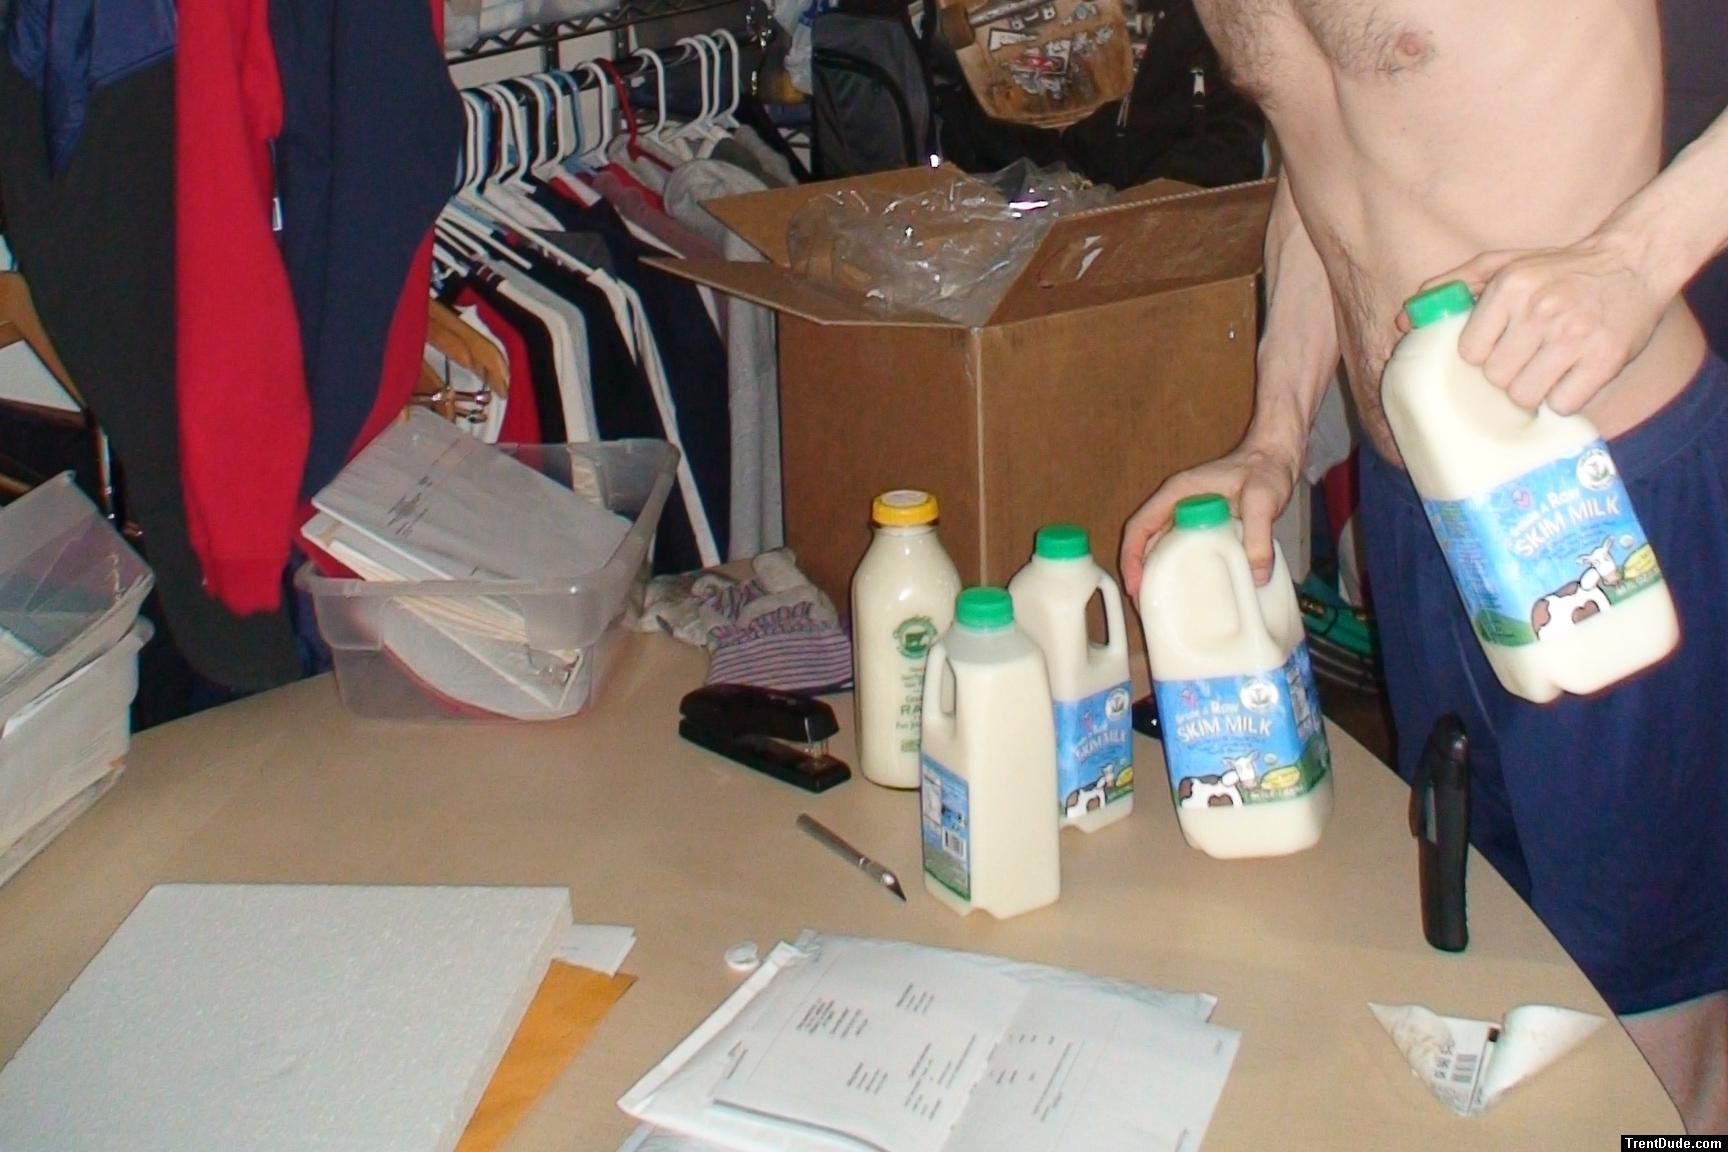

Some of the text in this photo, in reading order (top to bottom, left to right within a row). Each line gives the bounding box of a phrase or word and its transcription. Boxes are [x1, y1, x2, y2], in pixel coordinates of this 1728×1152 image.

[1514, 512, 1567, 557] SKIM
[1568, 495, 1621, 525] MILK
[1176, 717, 1220, 743] SKIM
[1225, 715, 1273, 737] MILK
